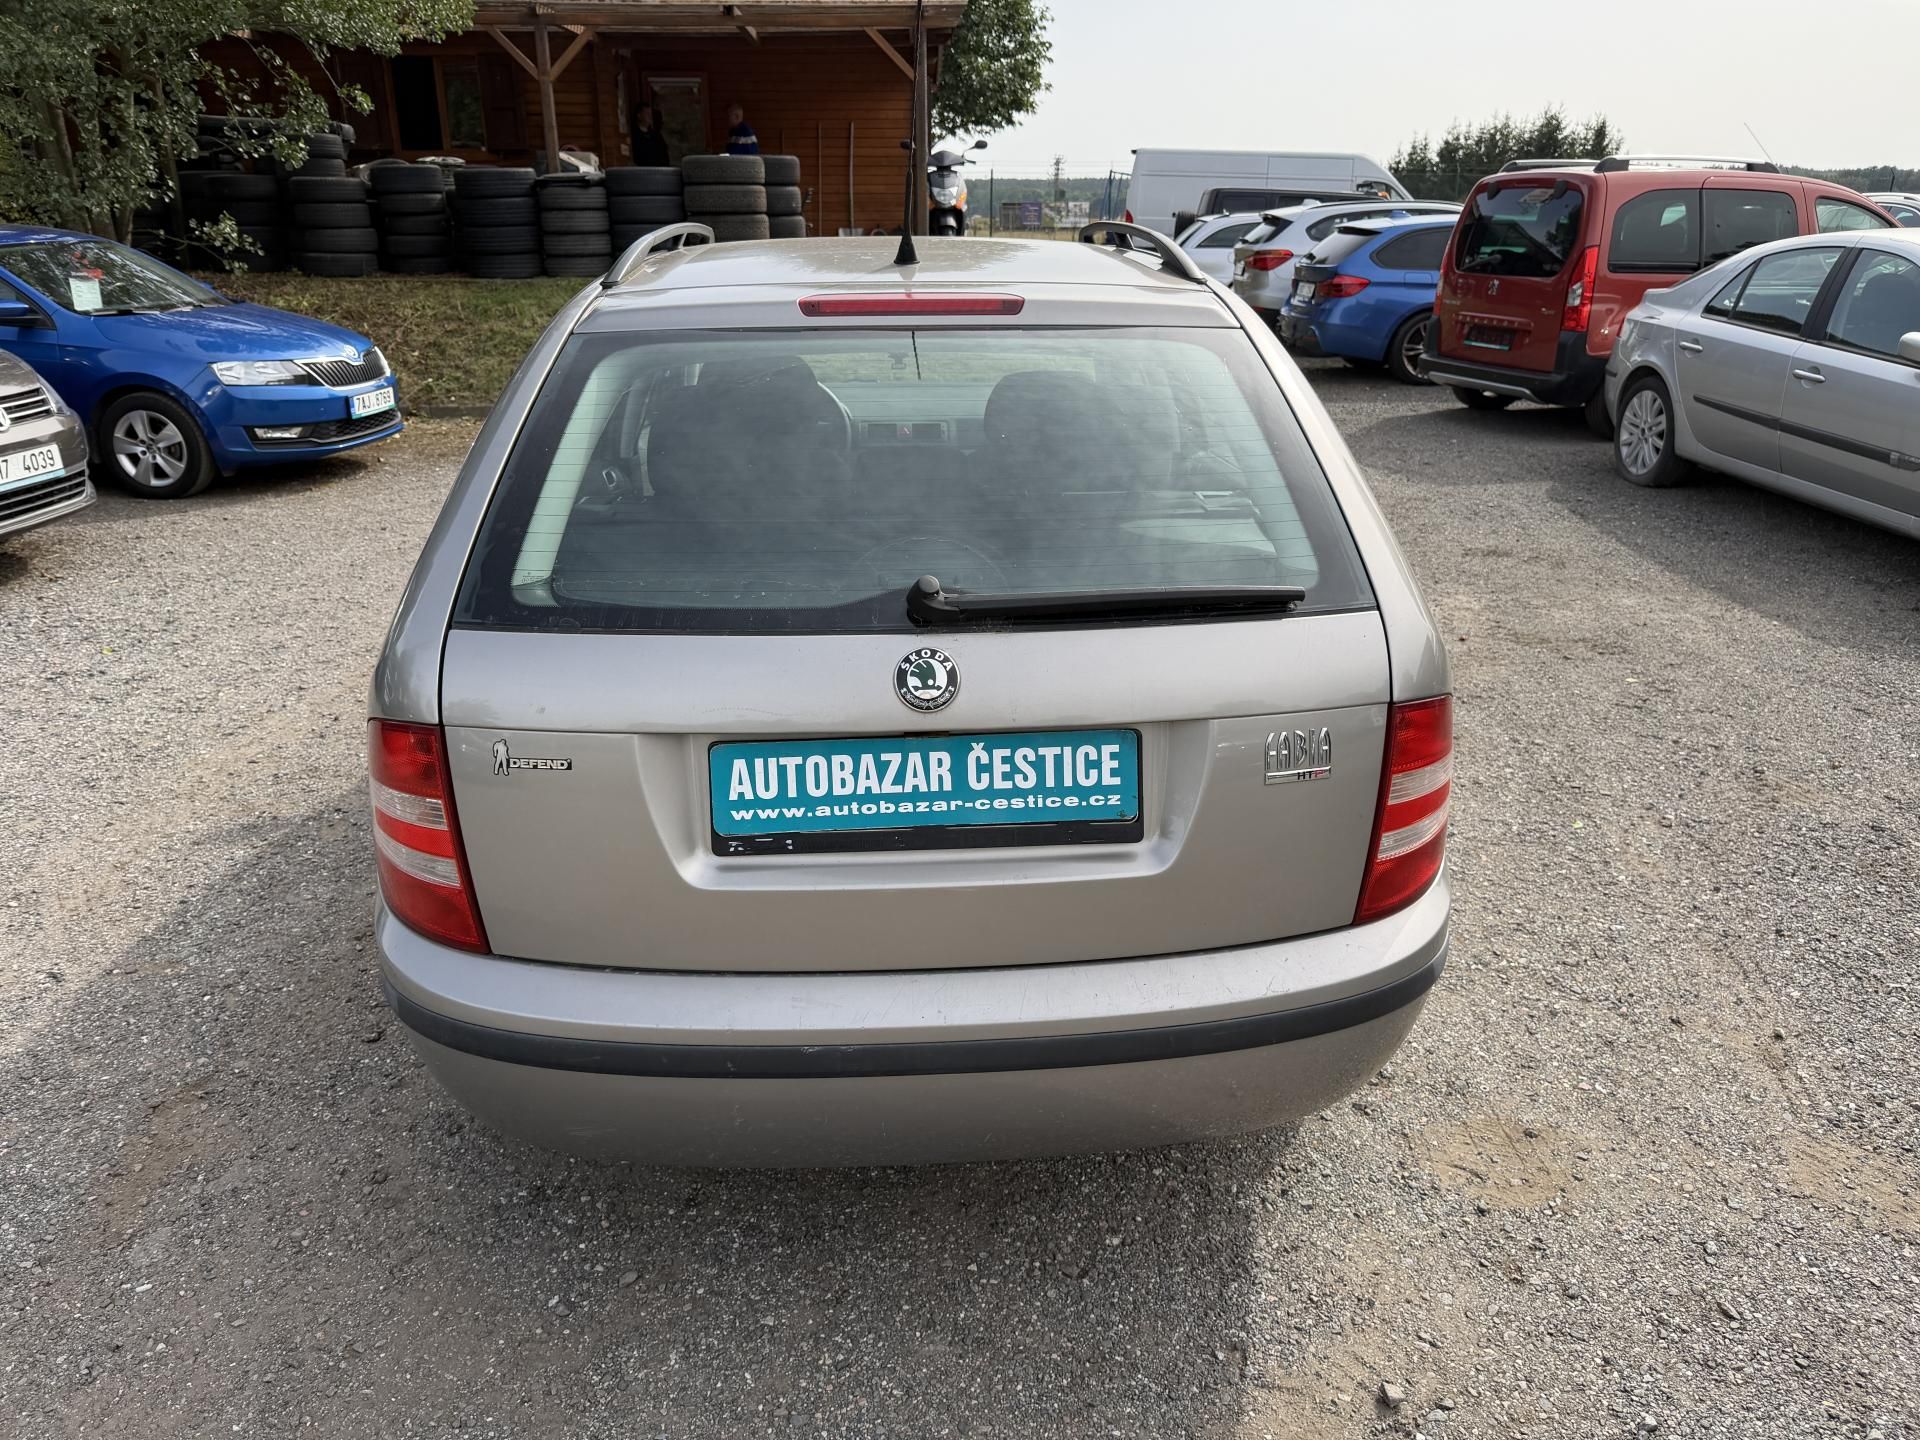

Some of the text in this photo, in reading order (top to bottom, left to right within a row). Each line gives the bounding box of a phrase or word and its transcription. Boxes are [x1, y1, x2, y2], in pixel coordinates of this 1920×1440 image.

[356, 394, 371, 412] 7AJ
[0, 449, 55, 480] 7 4039
[1264, 727, 1331, 771] FABIA
[509, 758, 569, 770] DEFEND
[728, 742, 1121, 801] AUTOBAZAR ČESTICE
[1297, 769, 1326, 780] HTP
[730, 793, 1121, 820] www.autobazar-cestice.cz
